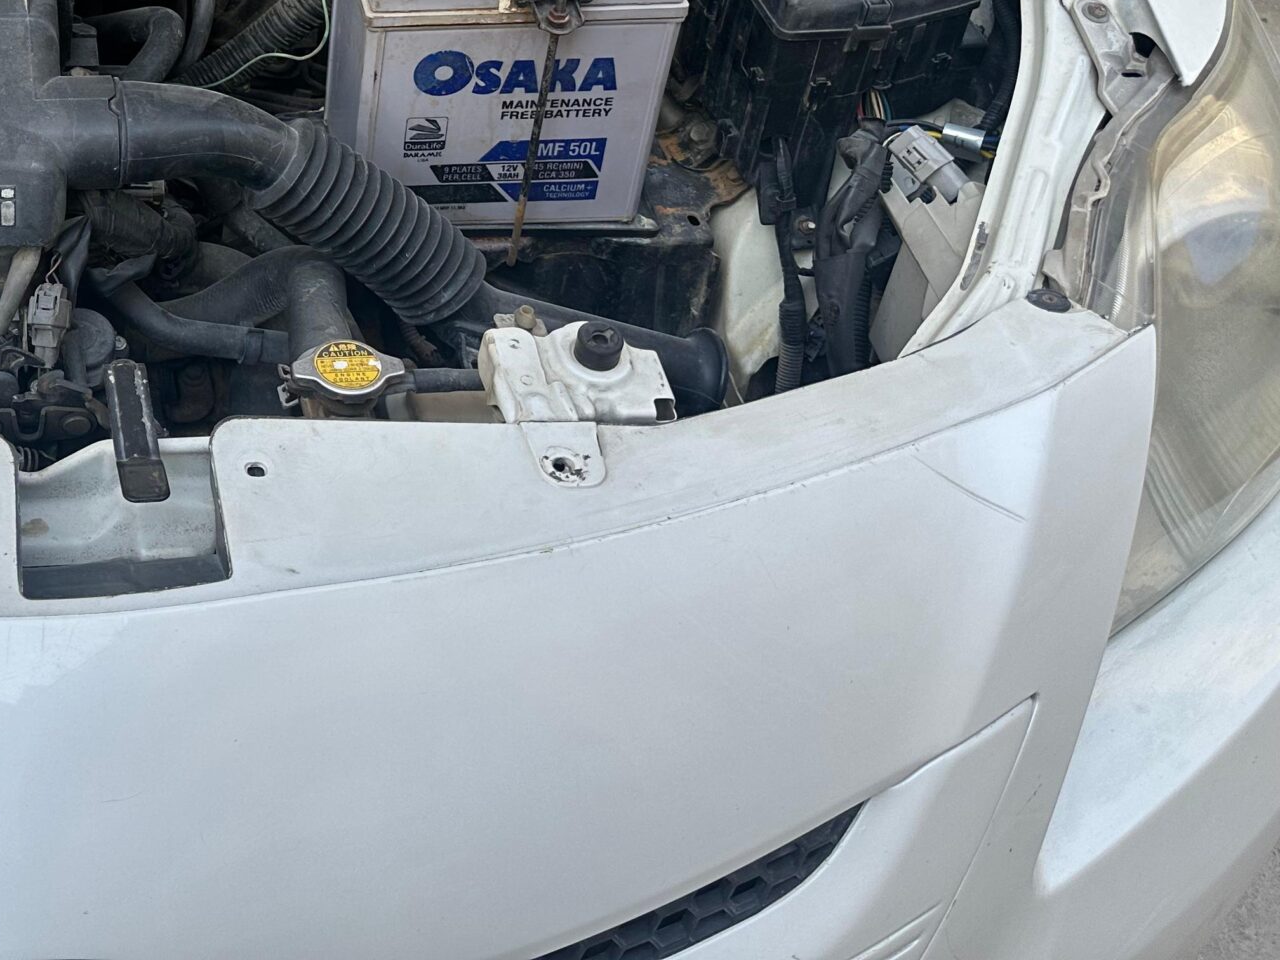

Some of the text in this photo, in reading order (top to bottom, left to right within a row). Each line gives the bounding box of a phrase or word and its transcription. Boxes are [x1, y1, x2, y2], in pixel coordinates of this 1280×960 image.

[413, 50, 618, 97] OSAKA
[544, 107, 613, 119] BATTERY
[537, 141, 600, 156] MF 50L
[451, 165, 482, 173] PLATES
[500, 164, 518, 172] 12V
[461, 172, 482, 180] CELL
